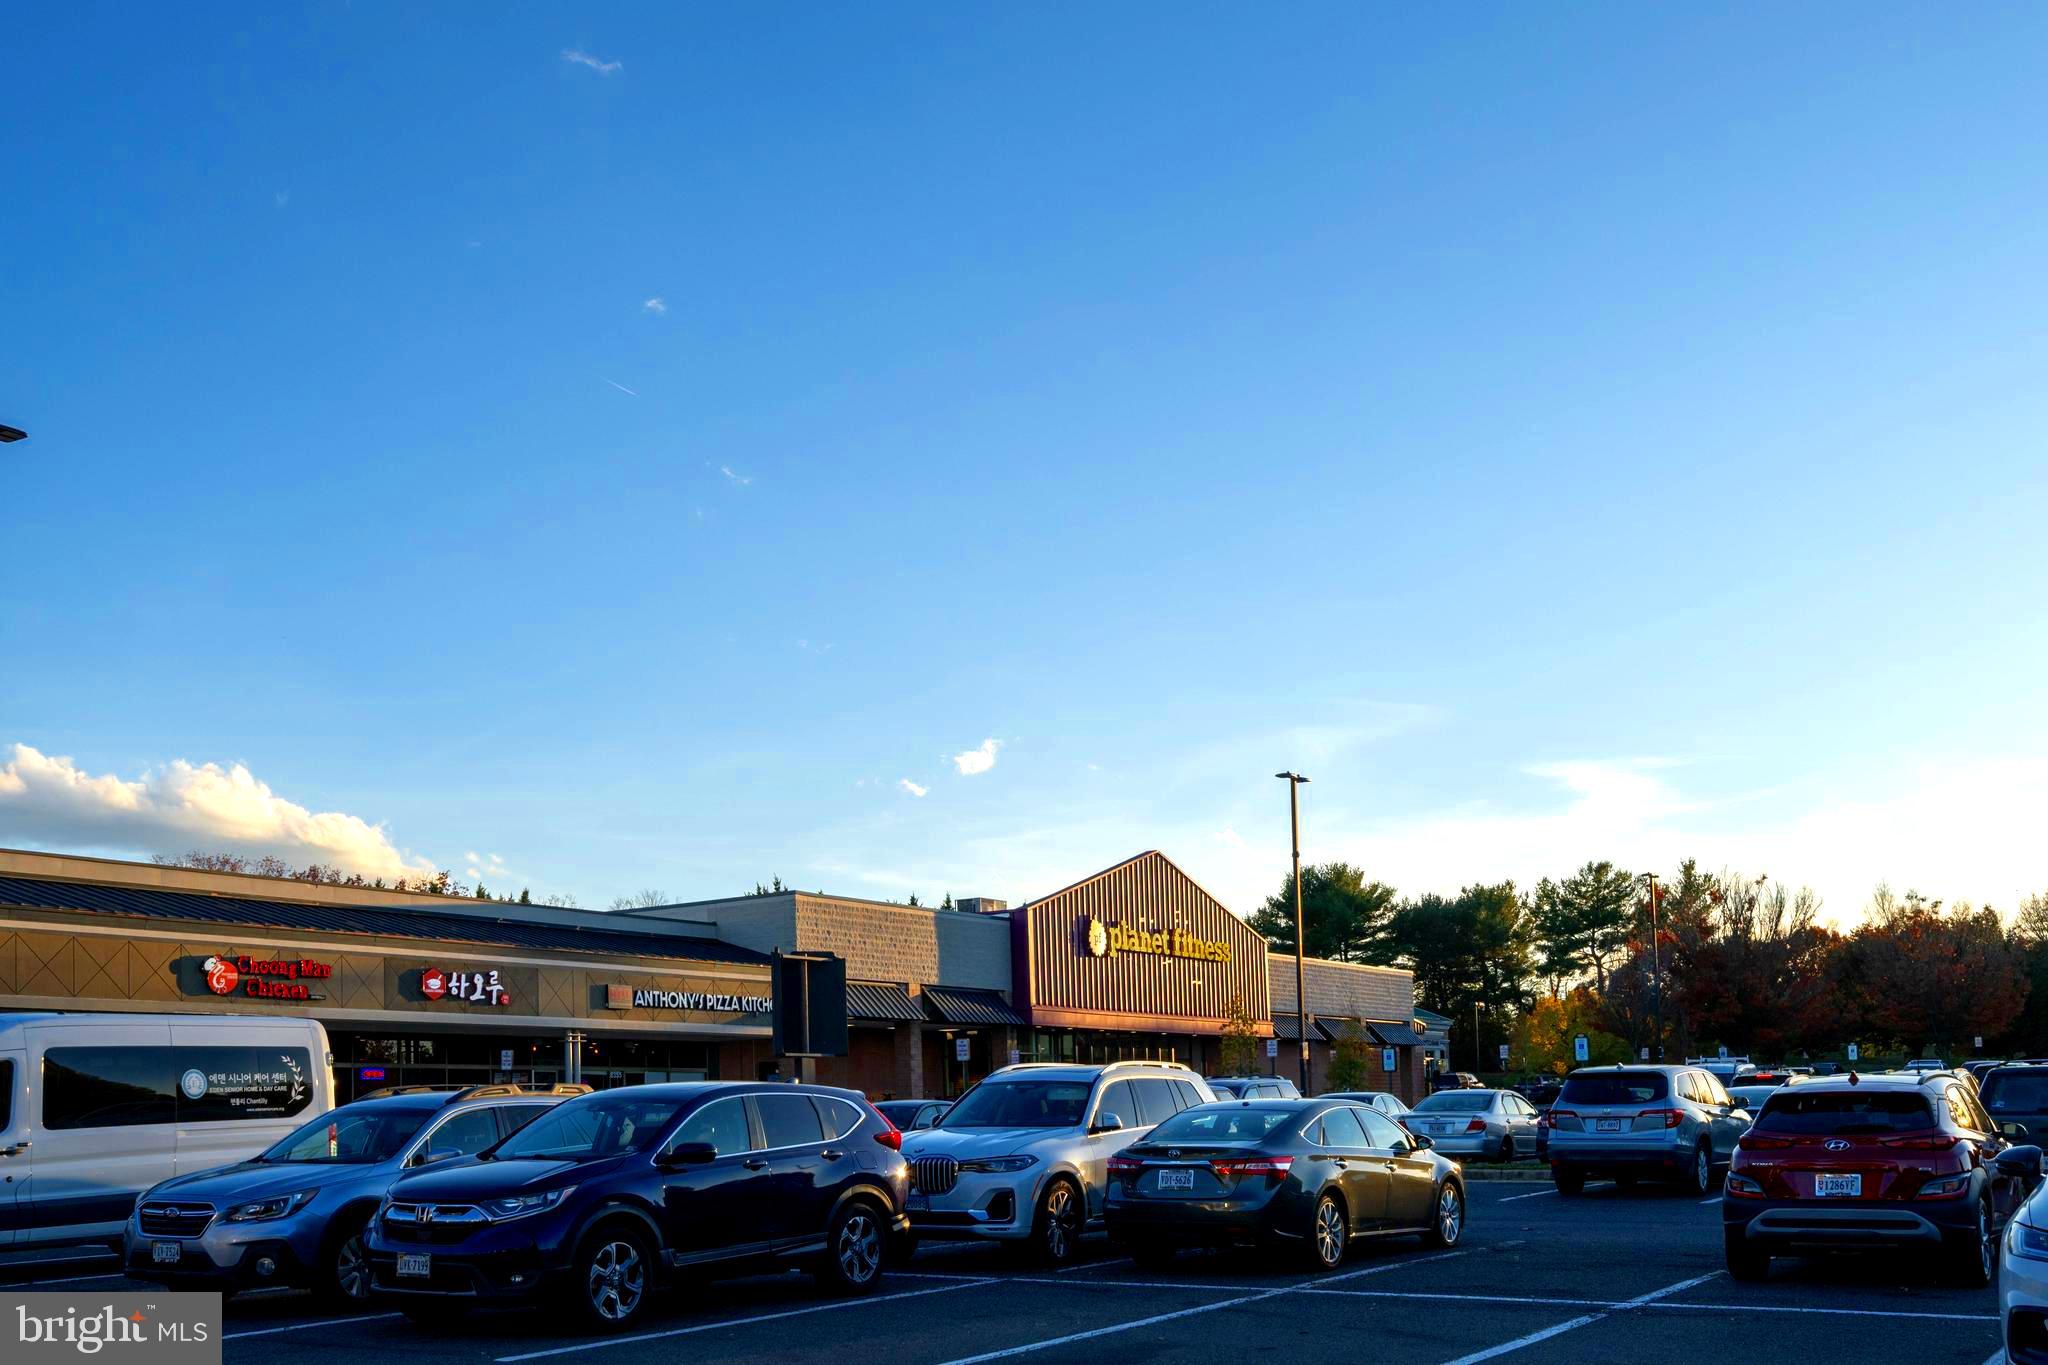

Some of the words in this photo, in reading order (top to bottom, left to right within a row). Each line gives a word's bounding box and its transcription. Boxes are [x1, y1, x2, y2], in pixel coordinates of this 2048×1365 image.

[1109, 920, 1170, 958] planet
[1172, 927, 1231, 962] fitness
[238, 955, 297, 980] Choong
[300, 959, 331, 977] Man
[247, 977, 309, 999] Chicken
[448, 970, 504, 1005] 하오루
[634, 990, 703, 1009] ANTHONY'S
[707, 995, 740, 1011] PIZZA
[228, 1072, 252, 1084] 시니어
[246, 1097, 268, 1105] Chantilly
